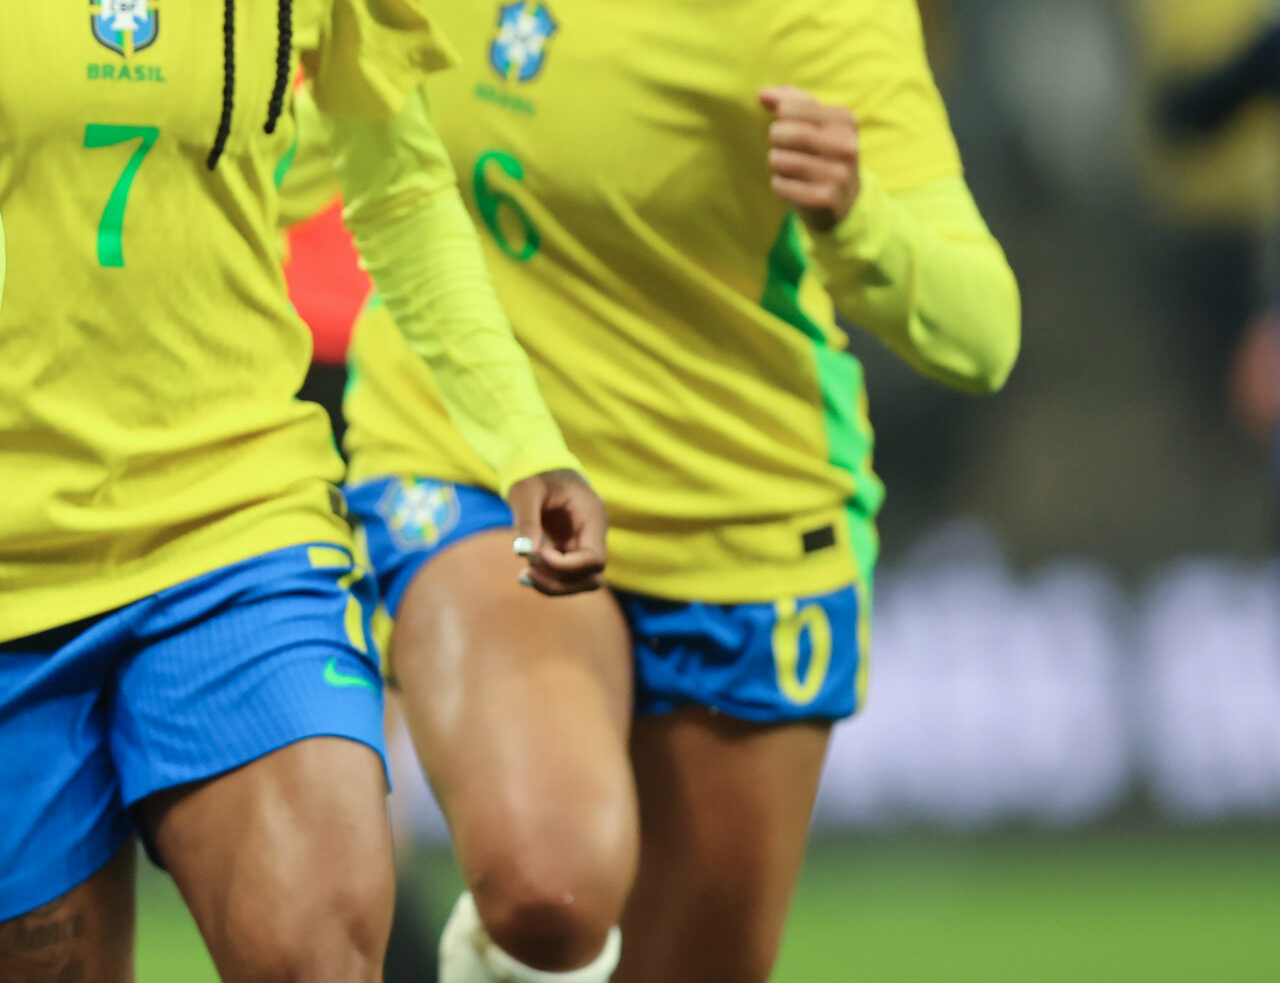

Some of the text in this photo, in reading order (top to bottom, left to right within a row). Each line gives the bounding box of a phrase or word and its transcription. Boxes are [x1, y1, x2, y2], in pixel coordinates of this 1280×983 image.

[86, 63, 167, 83] BRASIL
[83, 123, 161, 268] 7
[473, 149, 541, 261] 6
